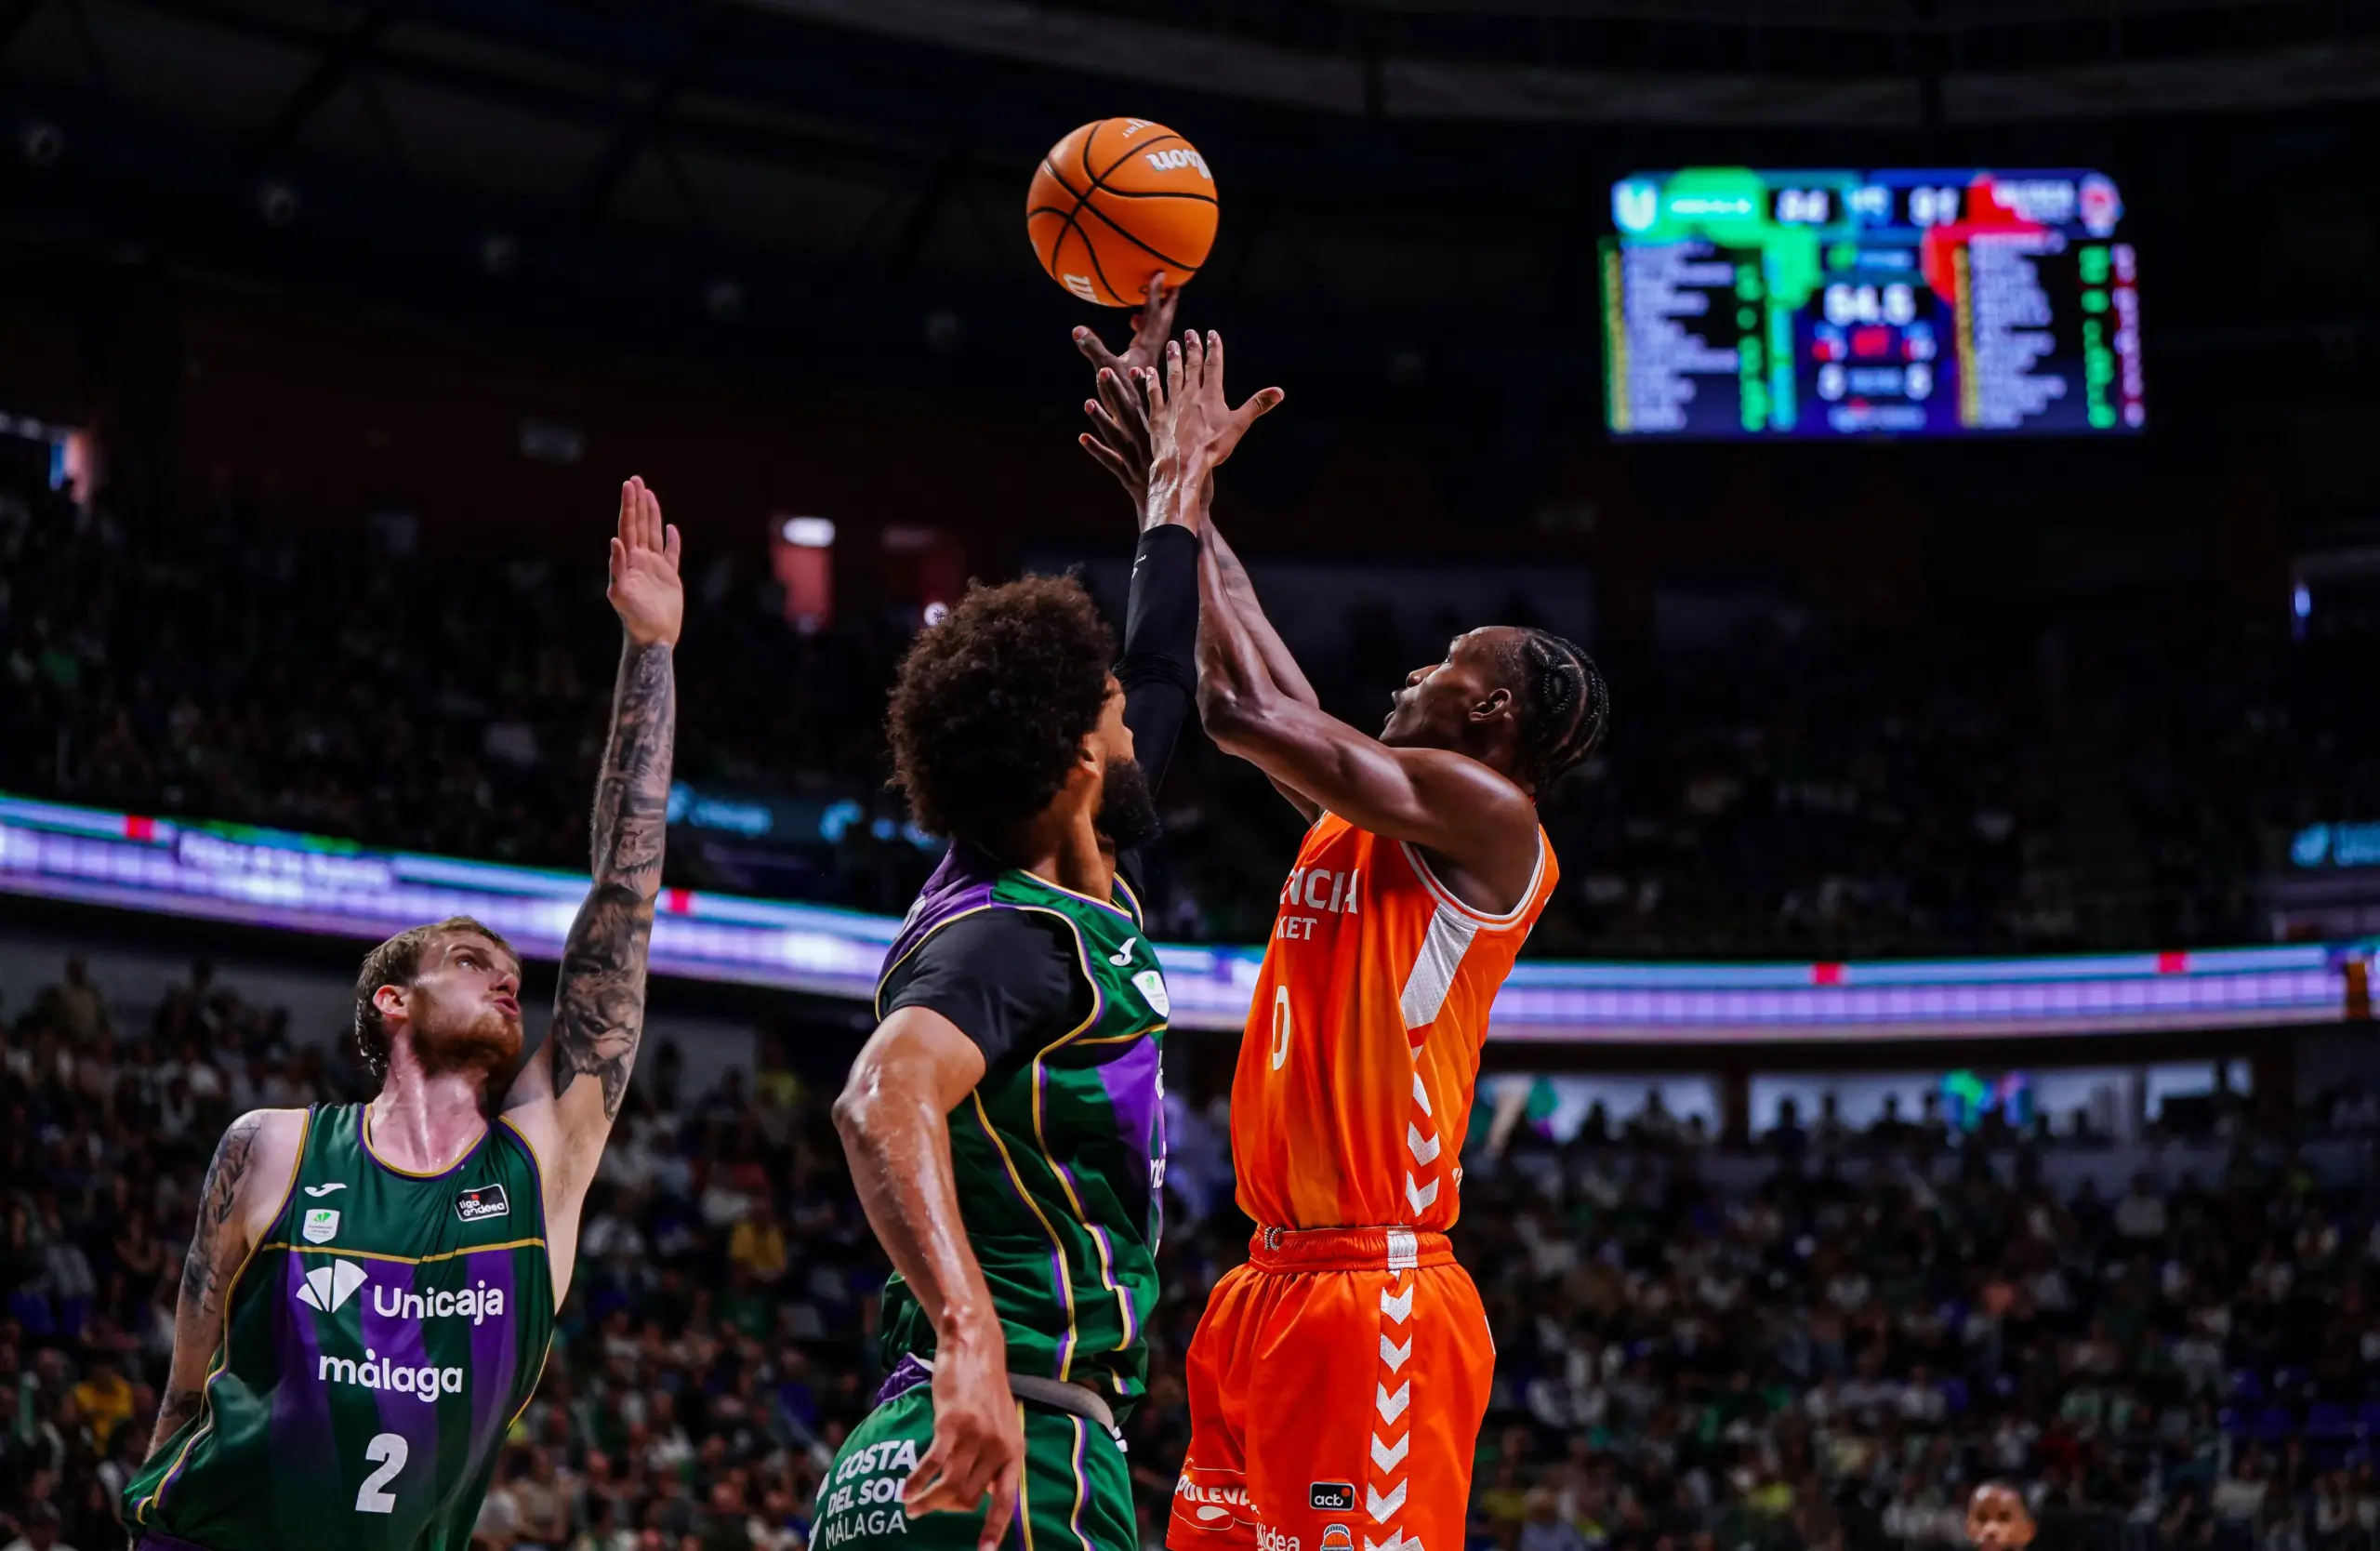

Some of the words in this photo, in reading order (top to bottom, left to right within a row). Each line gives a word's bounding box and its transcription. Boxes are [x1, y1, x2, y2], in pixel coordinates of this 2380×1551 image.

[1273, 985, 1290, 1070] 0
[374, 1279, 504, 1326] Unicaja
[355, 1433, 408, 1513] 2
[835, 1439, 918, 1485] COSTA
[826, 1485, 854, 1518] DEL
[1314, 1493, 1344, 1506] acb
[826, 1509, 907, 1550] MÁLAGA
